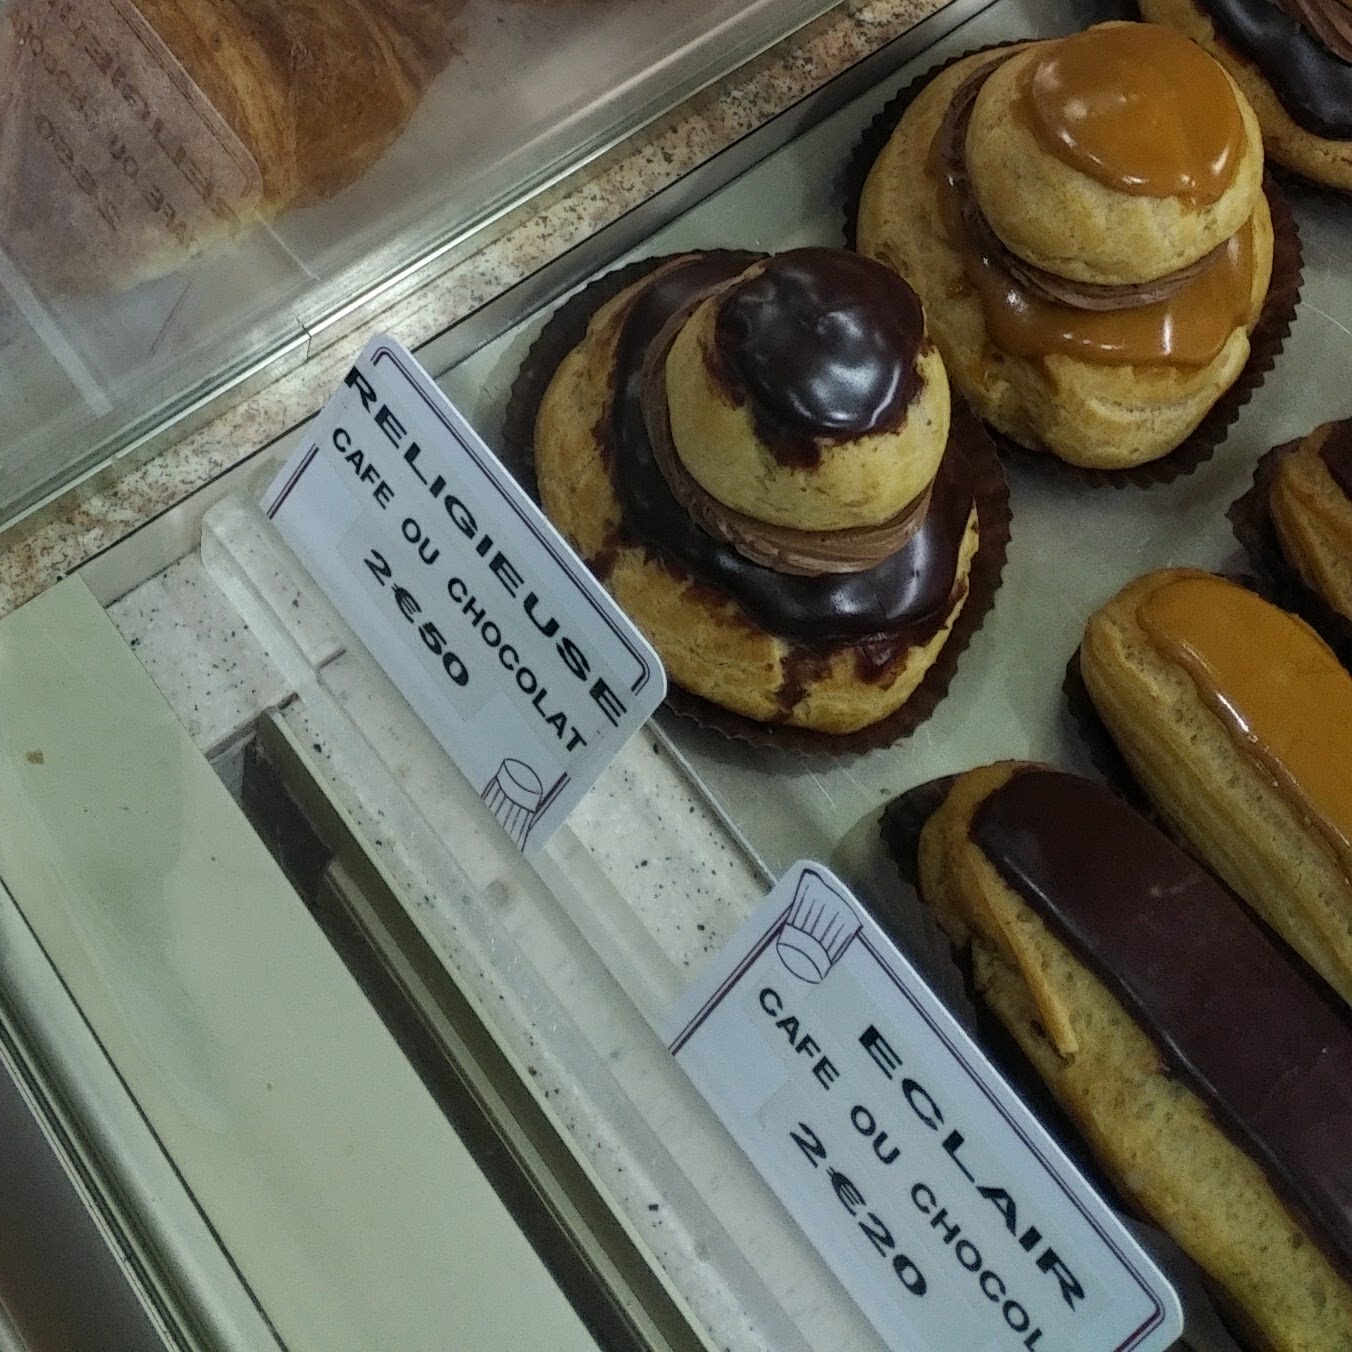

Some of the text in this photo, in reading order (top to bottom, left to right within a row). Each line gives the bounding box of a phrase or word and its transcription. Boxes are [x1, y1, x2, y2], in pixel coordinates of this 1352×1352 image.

[332, 426, 587, 754] CAFE OU CHOCOLAT
[343, 366, 627, 727] RELIGIEUSE
[364, 548, 470, 687] 2€50
[759, 987, 841, 1091] CAFE
[850, 1104, 901, 1166] OU
[859, 1024, 1086, 1312] ECLAIR
[789, 1121, 928, 1298] 2€20
